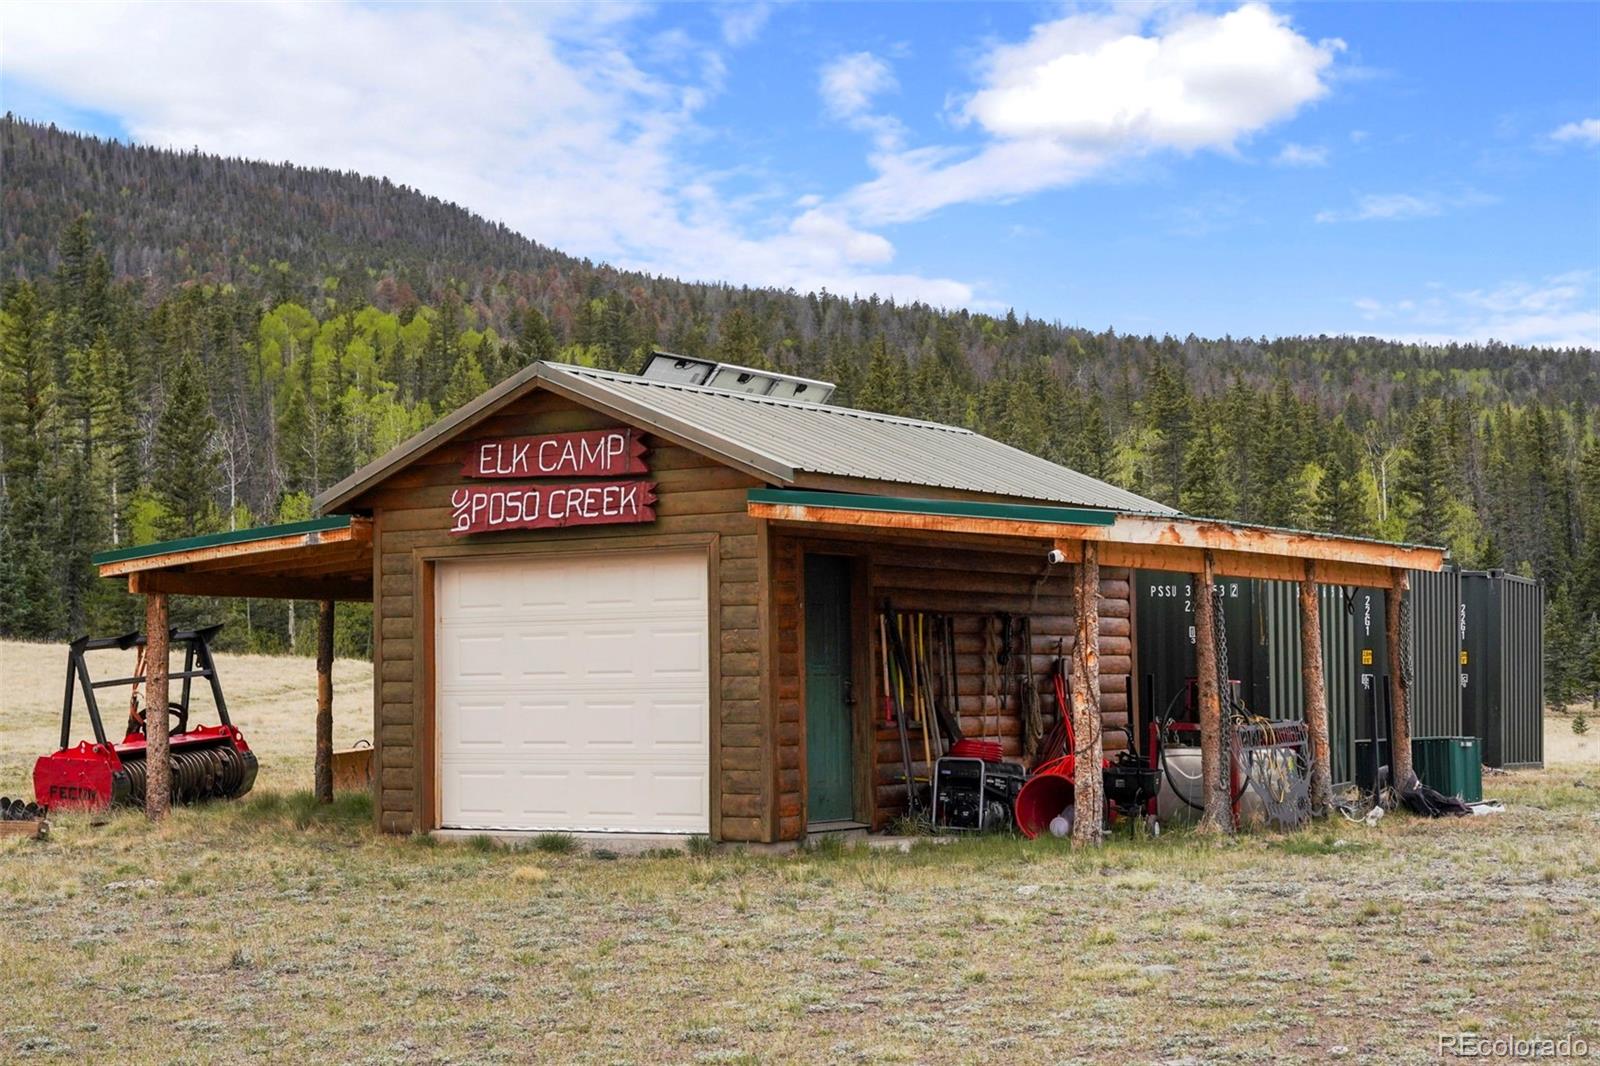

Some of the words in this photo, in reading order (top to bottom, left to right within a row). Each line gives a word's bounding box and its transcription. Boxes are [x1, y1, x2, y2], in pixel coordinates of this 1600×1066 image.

[480, 443, 531, 474] ELK
[538, 434, 625, 472] CAMP
[472, 491, 539, 525] POSO
[548, 486, 637, 519] CREEK
[1150, 585, 1177, 598] PSSU
